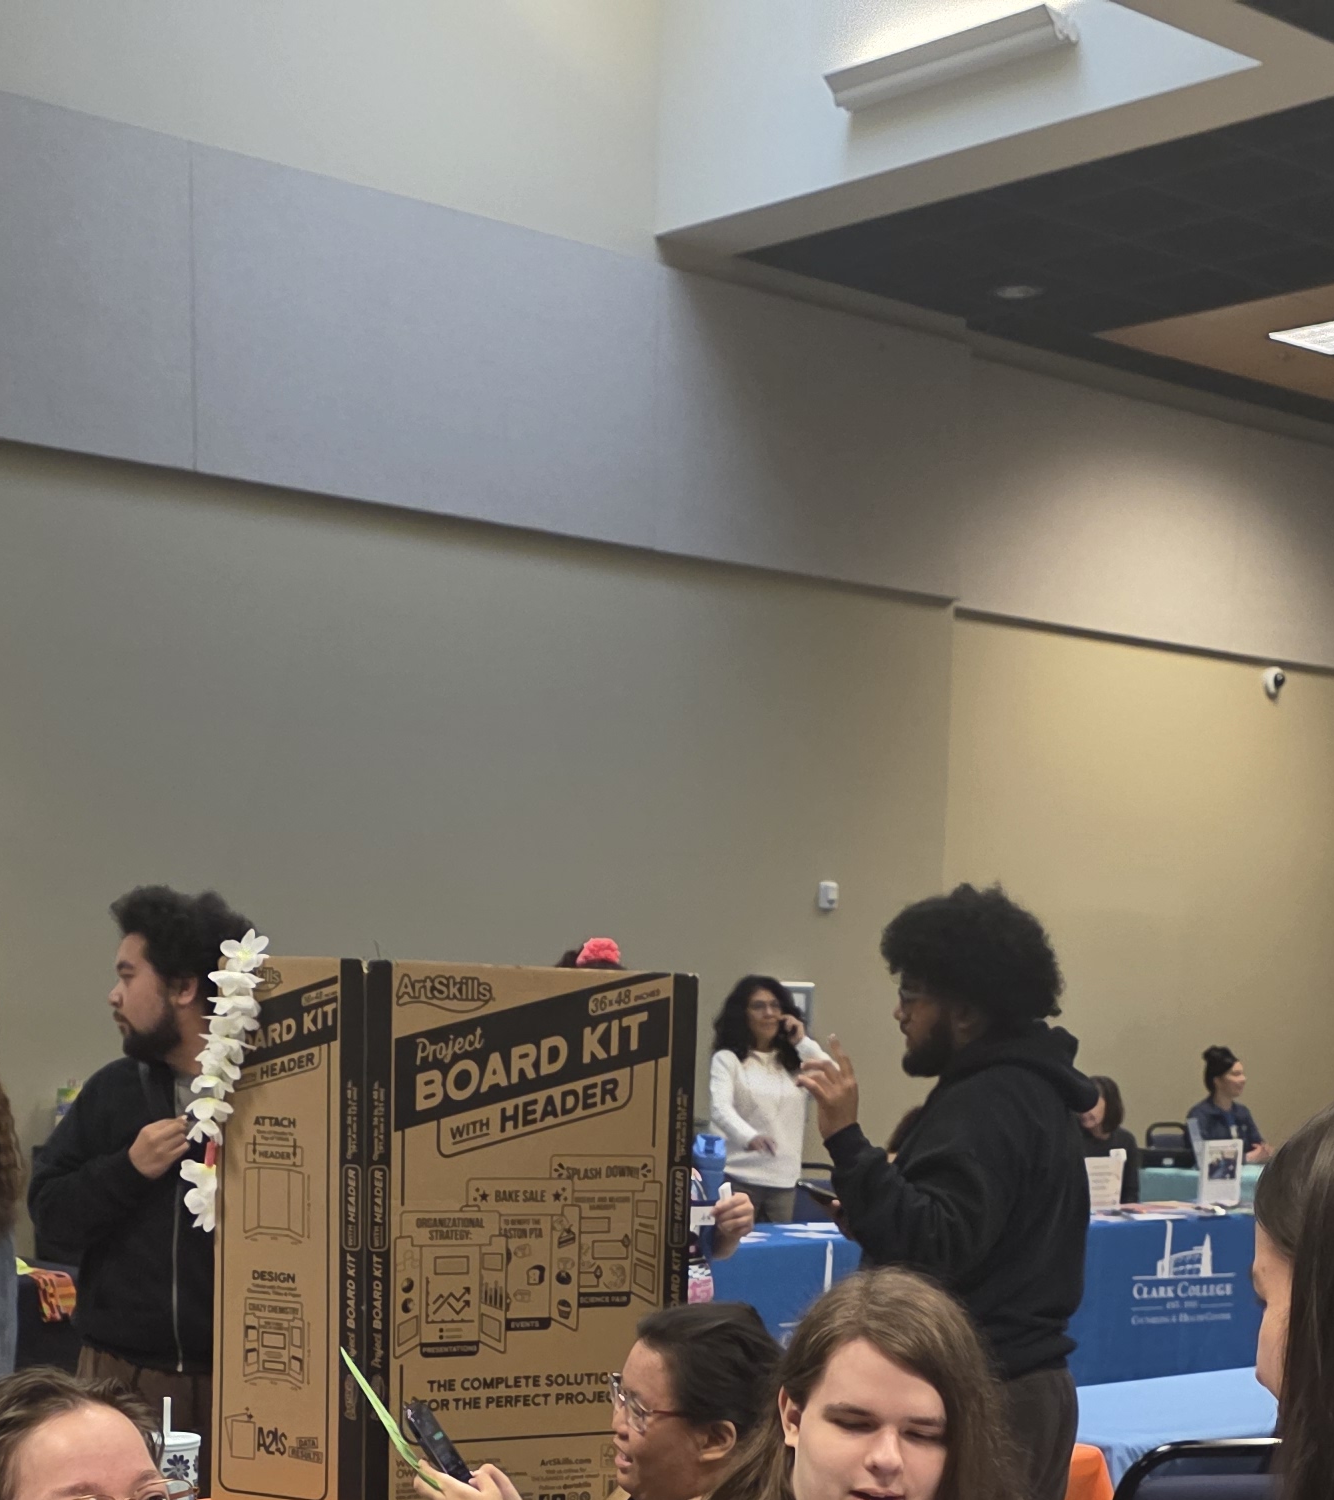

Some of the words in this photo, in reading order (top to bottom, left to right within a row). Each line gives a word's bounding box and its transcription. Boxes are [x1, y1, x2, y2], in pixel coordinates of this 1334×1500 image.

[396, 974, 493, 1003] ArtSkills
[303, 1003, 337, 1034] KIT
[416, 1027, 485, 1066] Project
[260, 1053, 315, 1079] HEADER
[416, 1035, 568, 1111] BOARD
[582, 1012, 649, 1064] KIT
[449, 1117, 490, 1141] WITH
[499, 1077, 620, 1133] HEADER
[253, 1116, 296, 1128] ATTACH
[259, 1150, 291, 1160] HEADER
[566, 1166, 601, 1180] SPLASH
[348, 1169, 357, 1223] HEADER
[373, 1170, 384, 1223] HEADER
[494, 1189, 521, 1202] BAKE
[522, 1190, 546, 1202] SALE
[674, 1171, 685, 1221] HEADER
[415, 1217, 485, 1229] ORGANIZATIONAL
[346, 1253, 357, 1276] KIT
[373, 1253, 384, 1277] KIT
[672, 1250, 682, 1270] KIT
[252, 1270, 296, 1283] DESIGN
[1132, 1282, 1175, 1299] CLARK
[1177, 1281, 1233, 1298] COLLEGE
[346, 1280, 357, 1329] BOARD
[373, 1280, 384, 1330] BOARD
[510, 1320, 539, 1329] EVENTS
[427, 1379, 456, 1393] THE
[460, 1375, 540, 1391] COMPLETE
[545, 1372, 610, 1388] SOLUTIO
[455, 1397, 481, 1410] THE
[485, 1394, 551, 1409] PERFECT
[555, 1391, 613, 1406] PROJEC
[540, 1457, 592, 1467] ArtSkills.com
